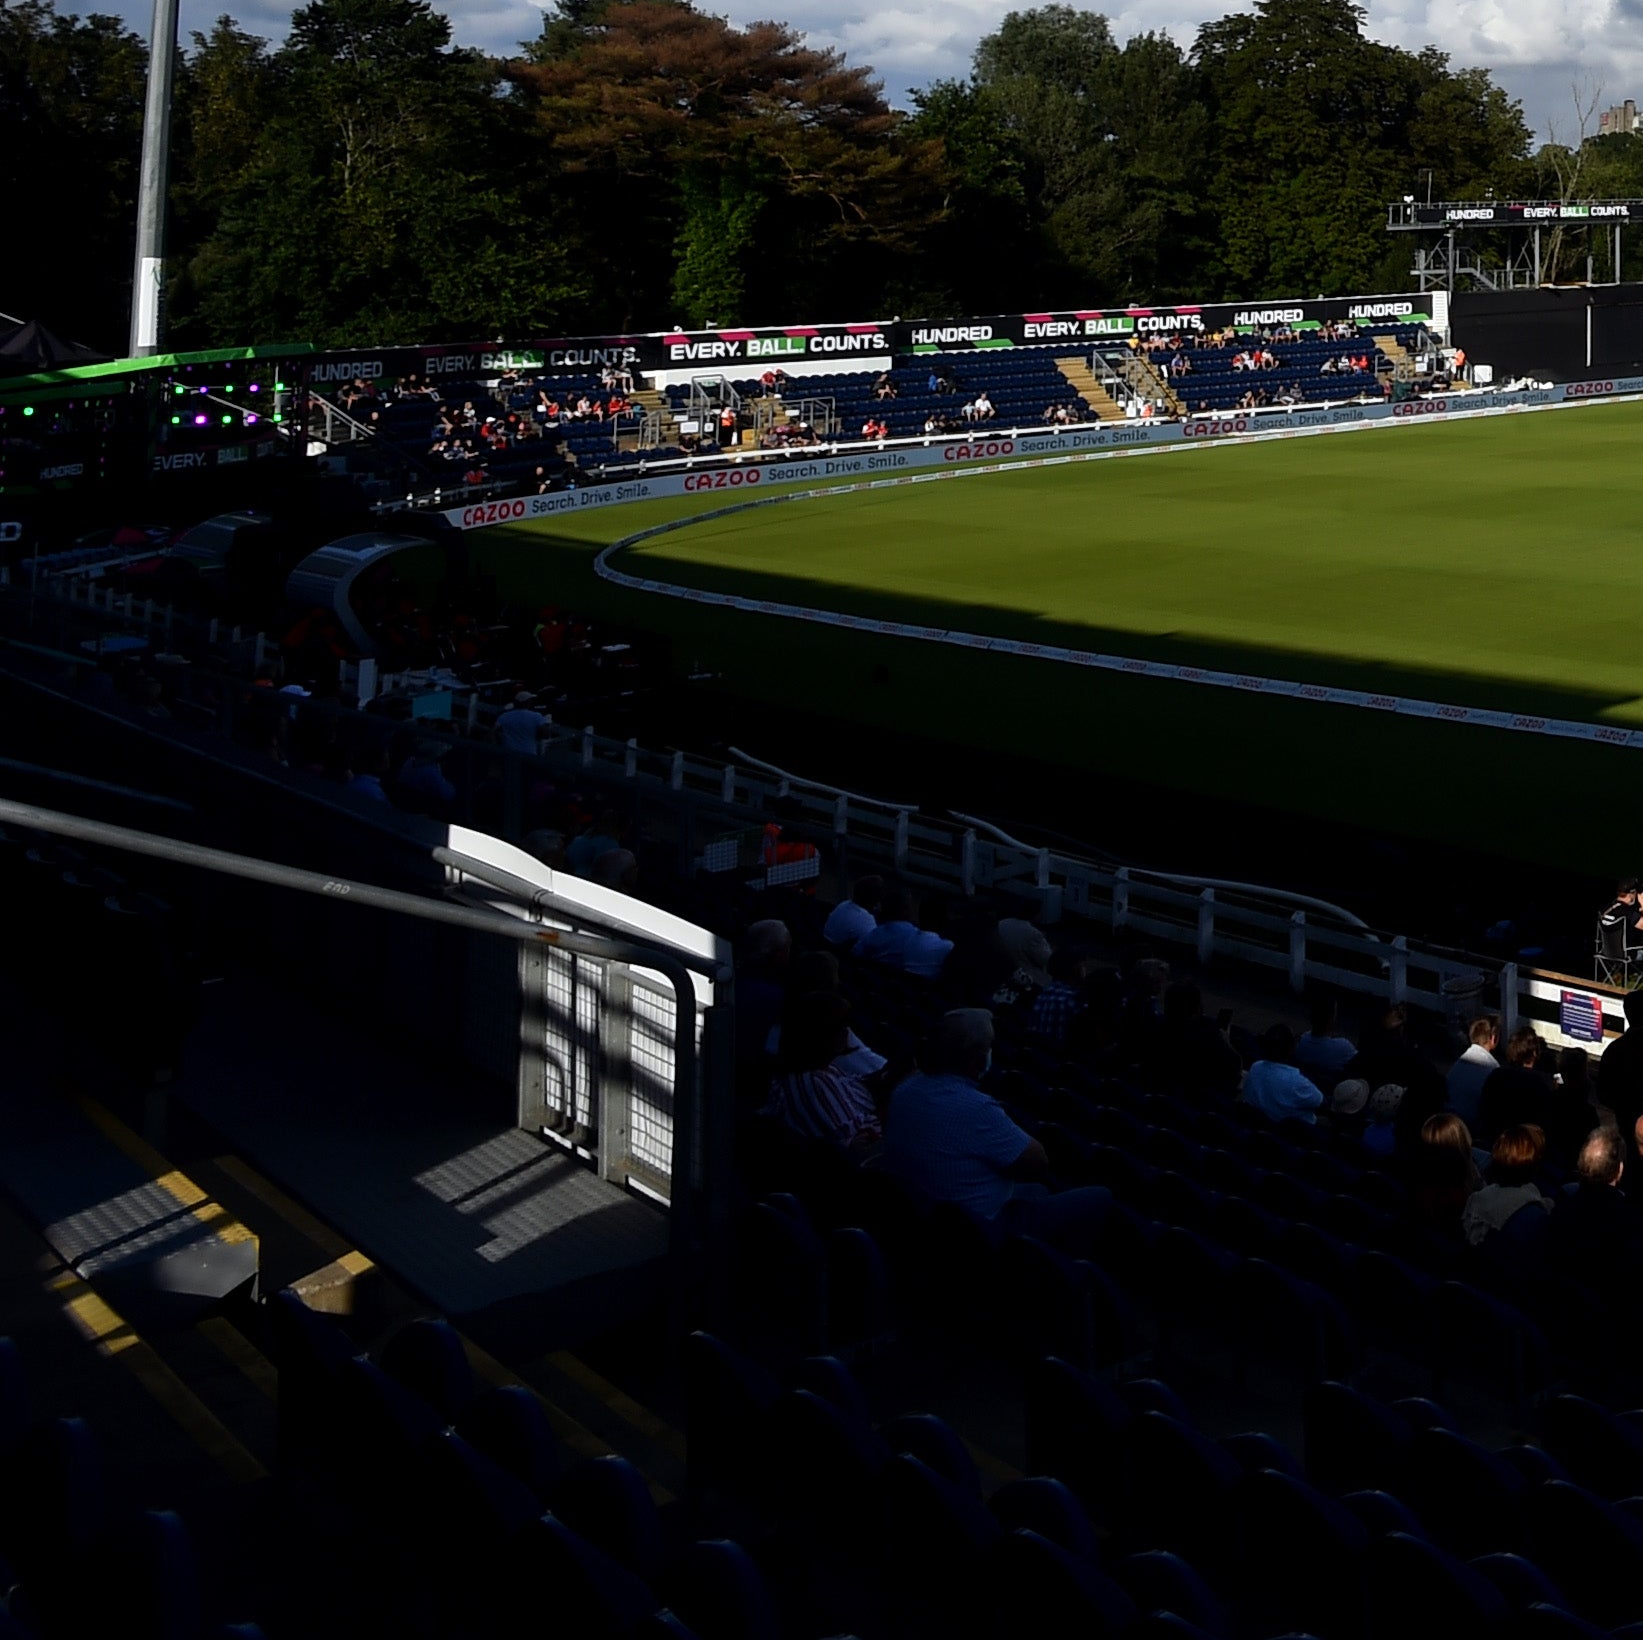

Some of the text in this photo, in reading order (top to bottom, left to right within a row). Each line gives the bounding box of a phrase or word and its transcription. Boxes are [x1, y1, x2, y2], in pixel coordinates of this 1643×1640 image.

[1446, 209, 1494, 220] HUNDRED
[1523, 207, 1558, 218] EVERY.
[1591, 205, 1630, 216] COUNTS.
[911, 325, 993, 345] HUNDRED
[1023, 321, 1082, 339] EVERY.
[1085, 318, 1133, 334] BALL.
[1234, 308, 1304, 326] HUNDRED
[1349, 302, 1413, 319] HUNDRED
[670, 333, 890, 361] EVERY. BALL. COUNTS.
[310, 361, 383, 383] HUNDRED
[426, 354, 476, 375] EVERY.
[549, 346, 641, 366] COUNTS.
[1566, 381, 1613, 395] CAZOO
[1183, 409, 1364, 437] CAZOO Search. Drive. Smile.
[1393, 400, 1446, 416] CAZOO
[944, 429, 1151, 461] CAZOO Search. Drive. Smile.
[684, 455, 908, 491] CAZOO Search. Drive. Smile.
[463, 483, 651, 527] CAZOO Search. Drive. Smile.
